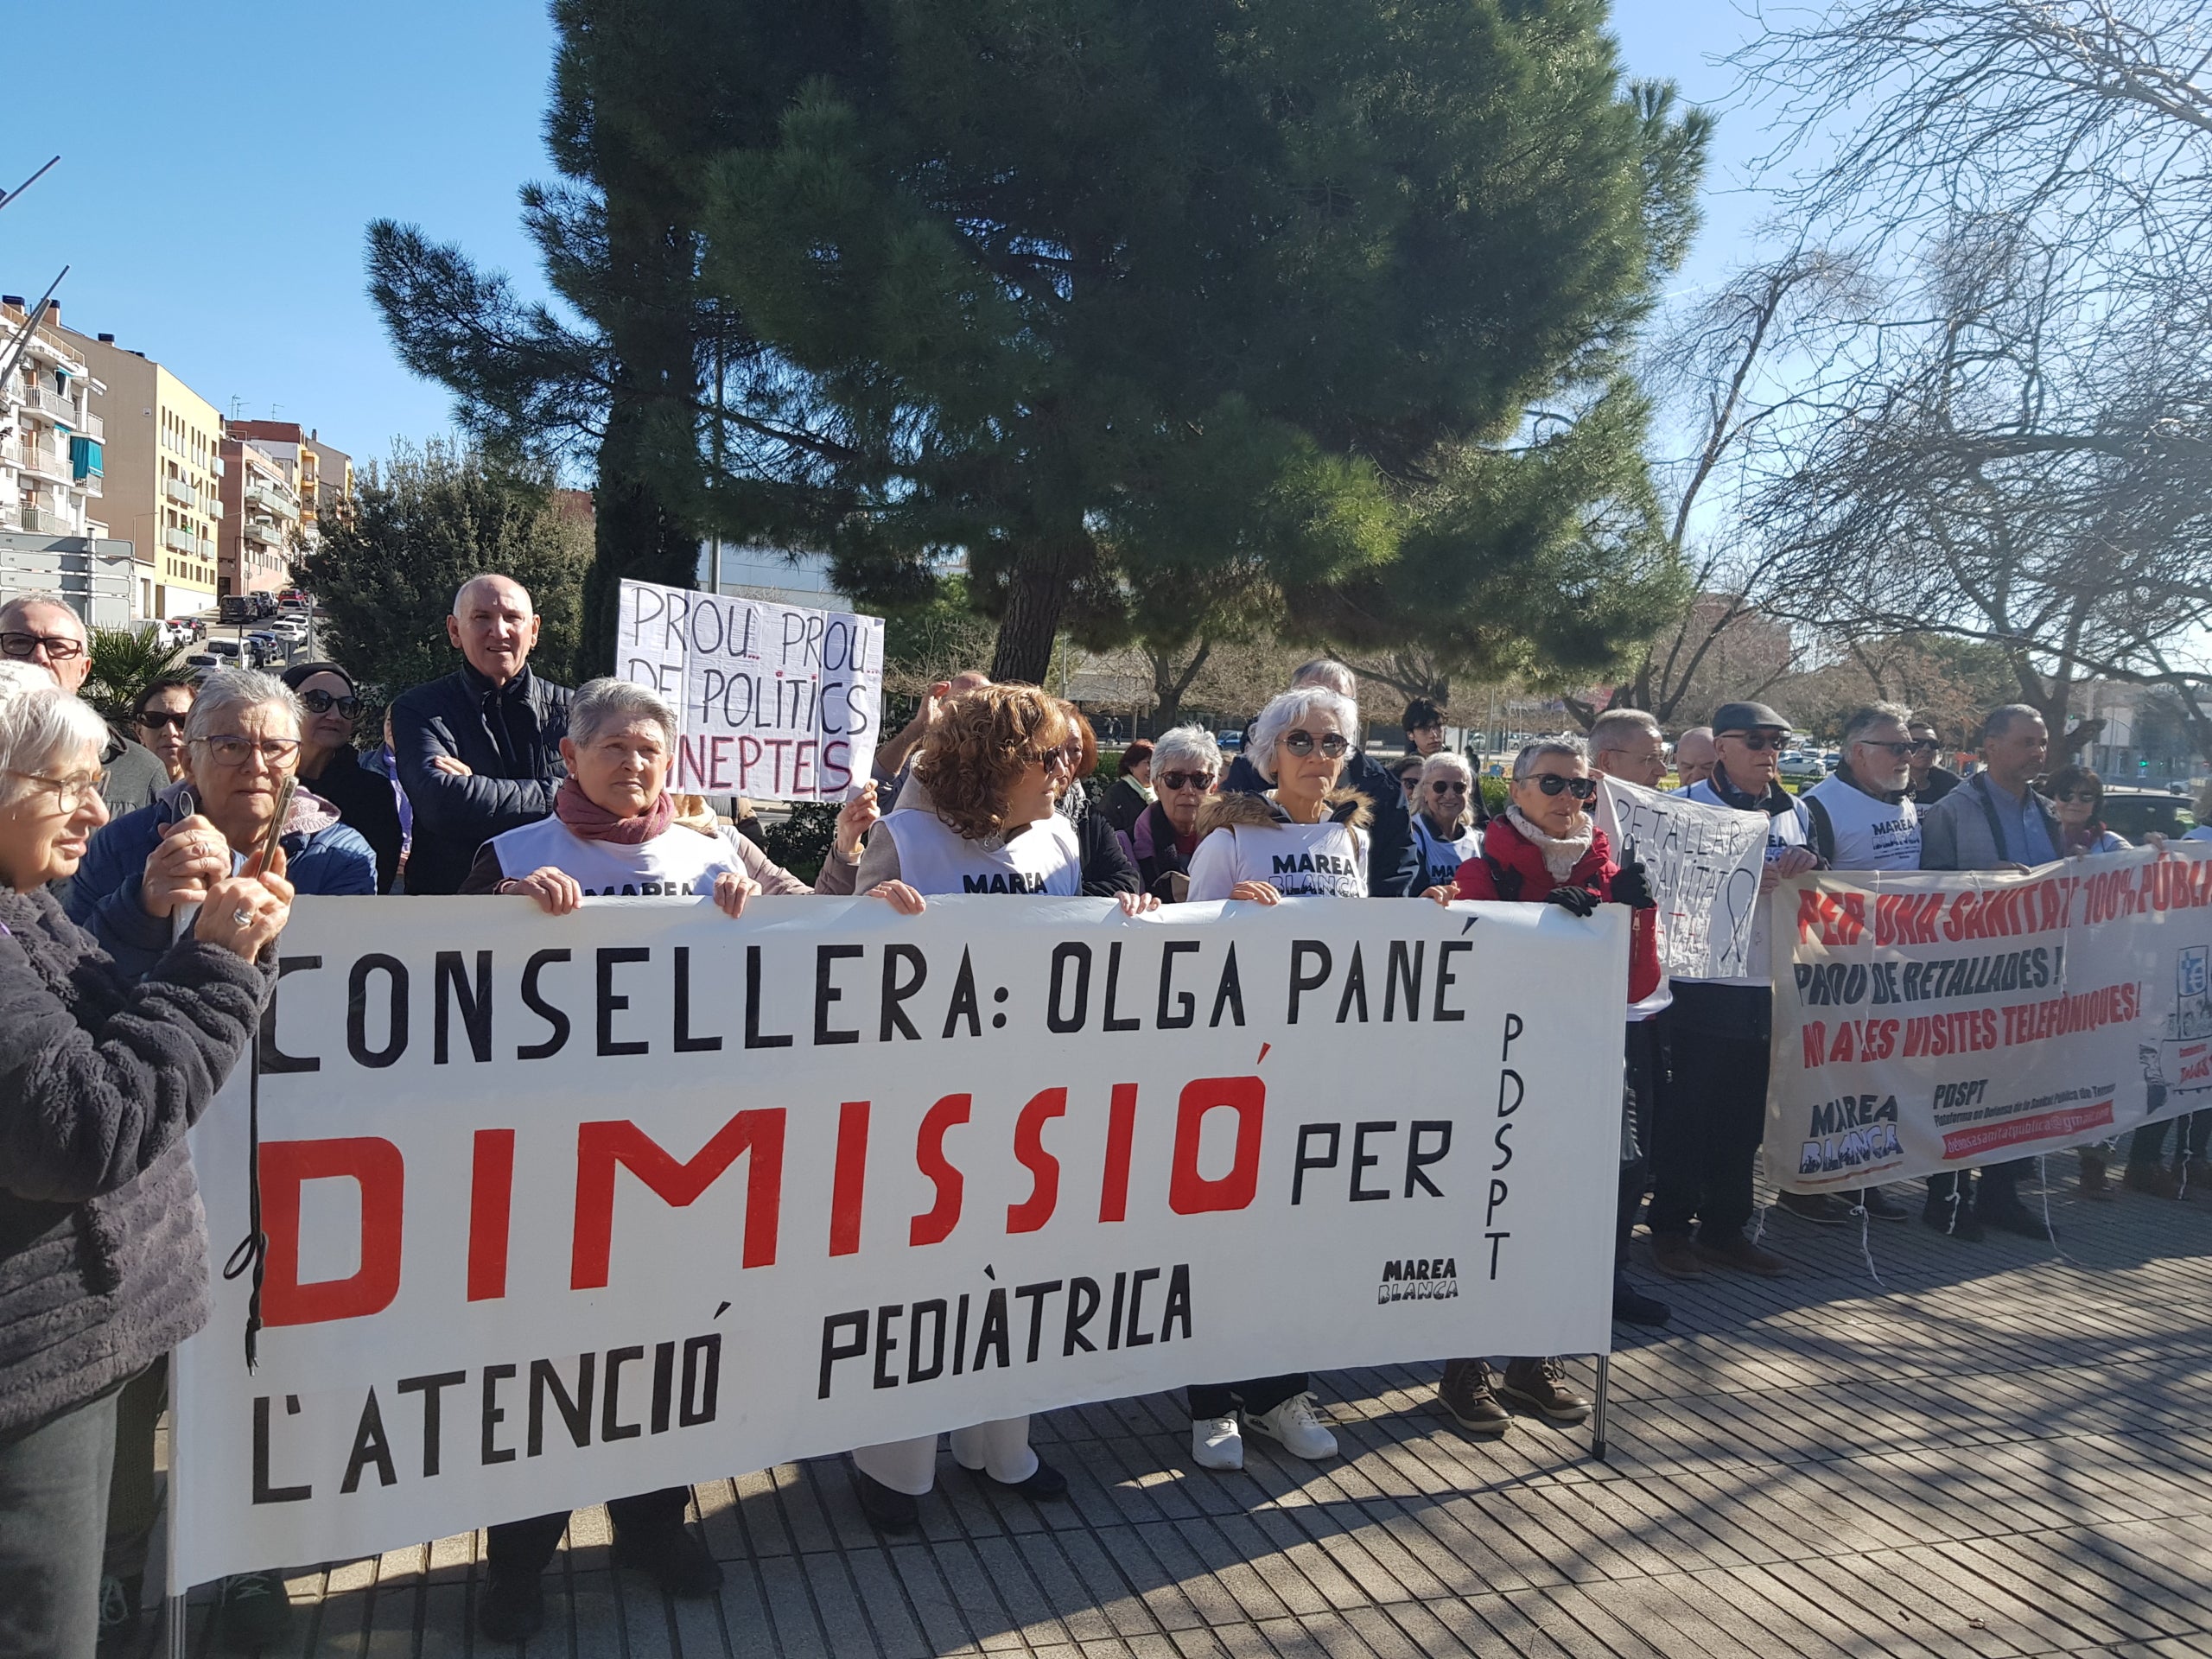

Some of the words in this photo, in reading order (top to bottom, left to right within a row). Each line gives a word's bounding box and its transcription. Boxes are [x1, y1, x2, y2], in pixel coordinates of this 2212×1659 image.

[1872, 818, 1915, 836] MAREA
[963, 873, 1048, 894] MAREA
[1268, 872, 1359, 898] BLANCA
[1272, 854, 1356, 875] MAREA
[1797, 889, 1865, 946] PER
[1874, 893, 1947, 947] UNA
[1942, 876, 2080, 942] SANITAT
[2083, 866, 2137, 925] 100%
[2137, 851, 2212, 912] PÚBLI
[258, 942, 1009, 1075] CONSELLERA:
[1046, 940, 1246, 1033] OLGA
[1287, 917, 1478, 1025] PANÉ
[1793, 963, 1869, 1007] PROU
[1869, 962, 1901, 1005] DE
[1903, 949, 2050, 1002] RETALLADES
[1802, 1020, 1826, 1069] NO
[1903, 1008, 1998, 1057] VISITES
[2001, 981, 2143, 1046] TELEFÒNIQUES!
[1932, 1079, 1989, 1109] PDSPT
[1809, 1095, 1898, 1138] MAREA
[1798, 1123, 1904, 1173] BLANCA
[258, 1042, 1272, 1327] DIMISSIÓ
[1291, 1121, 1452, 1206] PER
[1382, 1257, 1458, 1282] MAREA
[1377, 1281, 1459, 1306] BLANCA
[817, 1263, 1192, 1400] PEDIÀTRICA
